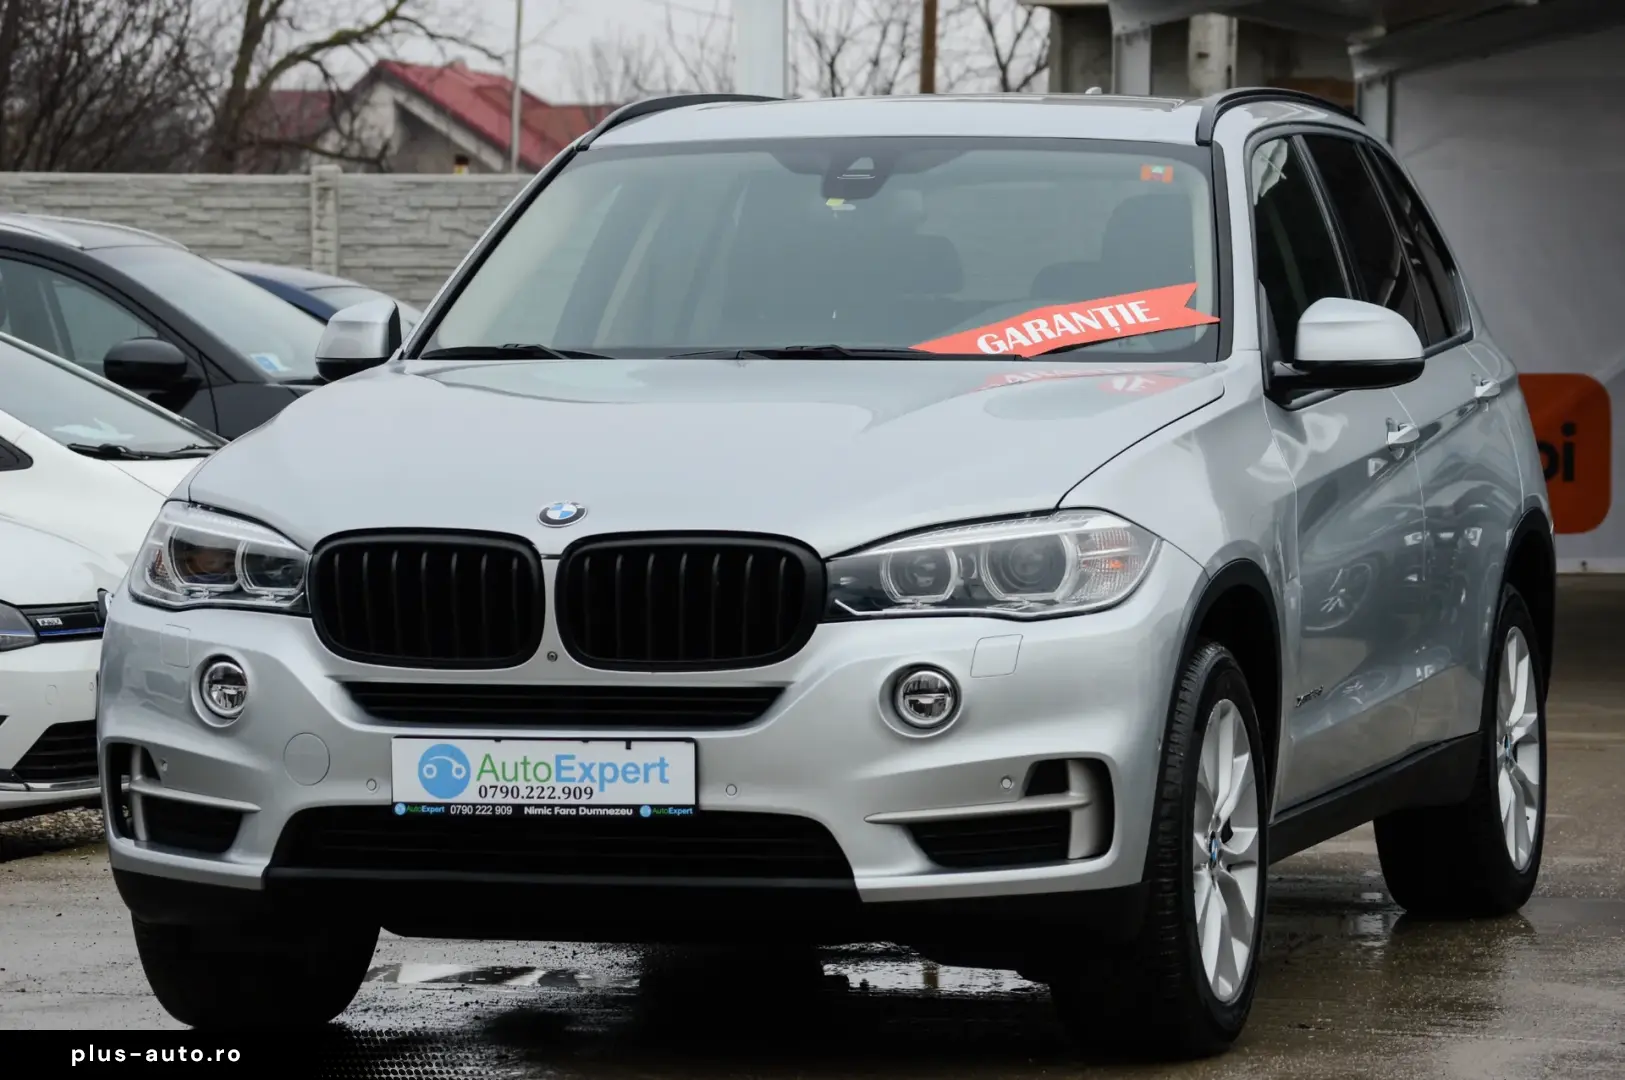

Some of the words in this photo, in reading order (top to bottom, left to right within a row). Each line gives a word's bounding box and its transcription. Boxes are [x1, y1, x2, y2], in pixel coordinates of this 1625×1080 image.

[476, 753, 670, 792] AutoExpert
[478, 784, 595, 800] 0790.222.909
[405, 805, 445, 814] AutoExpert
[450, 804, 473, 815] 0790
[475, 805, 492, 815] 222
[495, 805, 513, 815] 909
[524, 806, 552, 815] Nimic
[554, 806, 576, 815] Fara
[578, 806, 633, 816] Dumnezeu
[652, 807, 693, 816] AutoExpert
